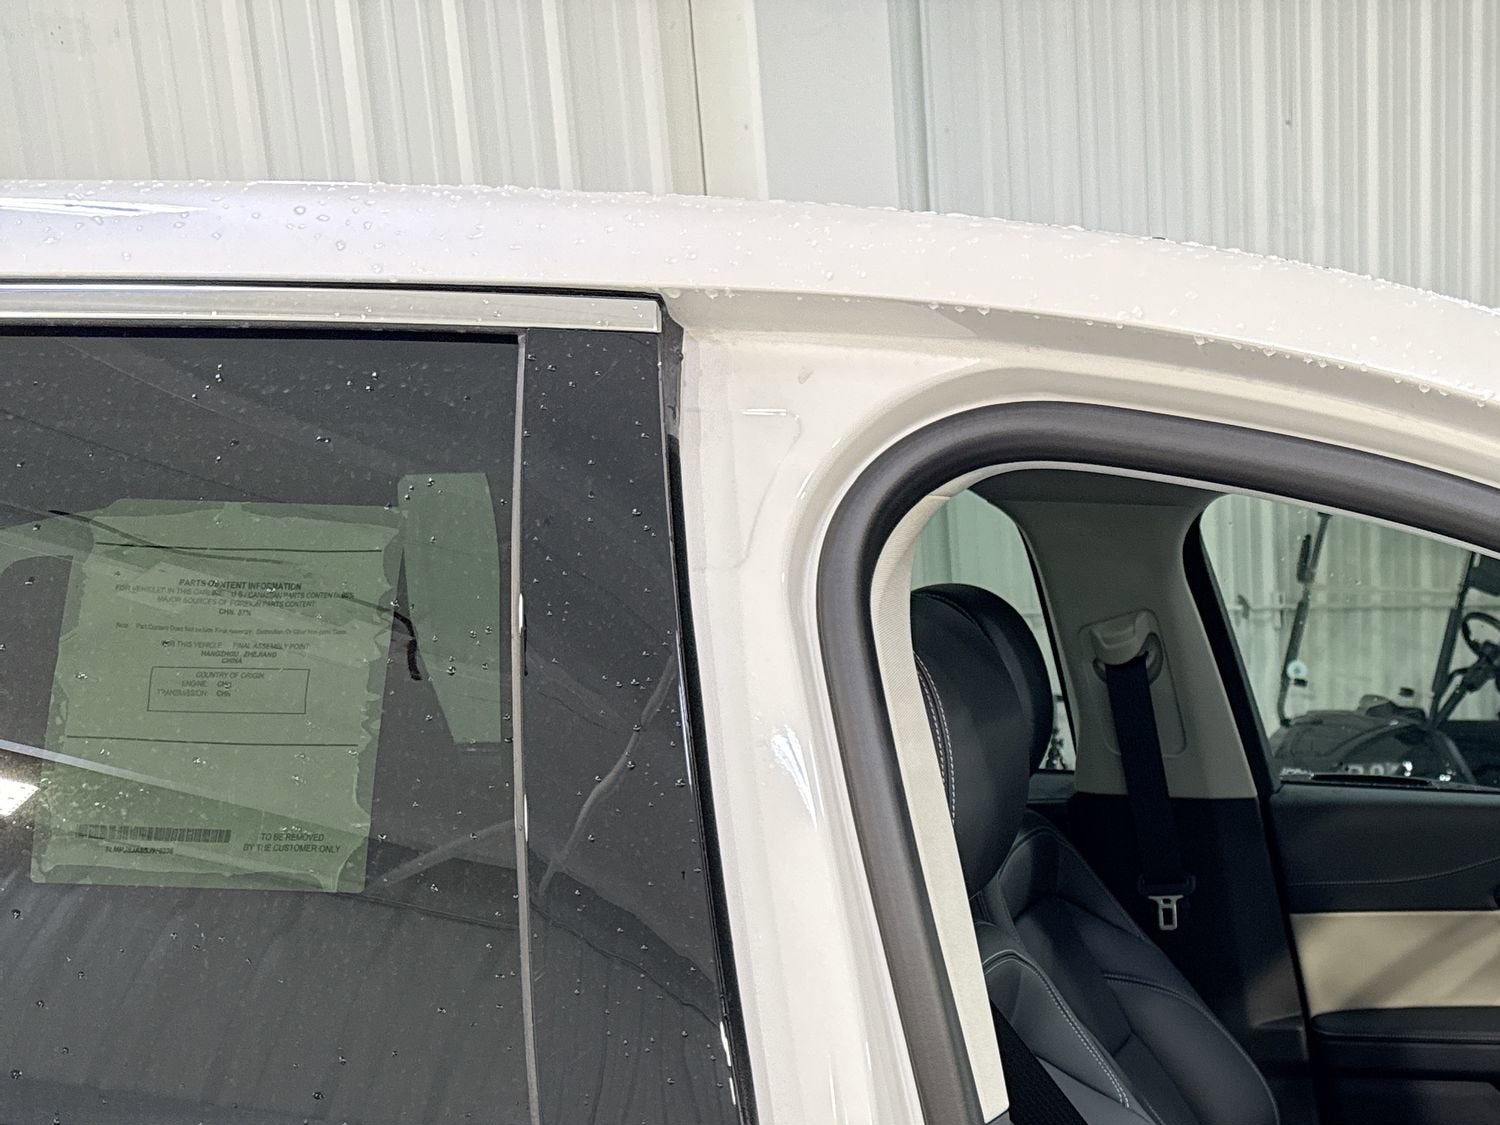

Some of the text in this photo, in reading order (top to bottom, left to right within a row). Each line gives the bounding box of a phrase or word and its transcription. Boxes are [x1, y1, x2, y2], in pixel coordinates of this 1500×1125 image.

[178, 578, 206, 588] PARTS
[248, 582, 302, 591] INFORMATION
[195, 671, 229, 679] COUNTRY
[229, 671, 239, 679] OF
[261, 832, 325, 842] TO BE REMOVED
[243, 843, 255, 852] BY
[273, 844, 318, 853] CUSTOMER
[319, 844, 341, 854] ONLY
